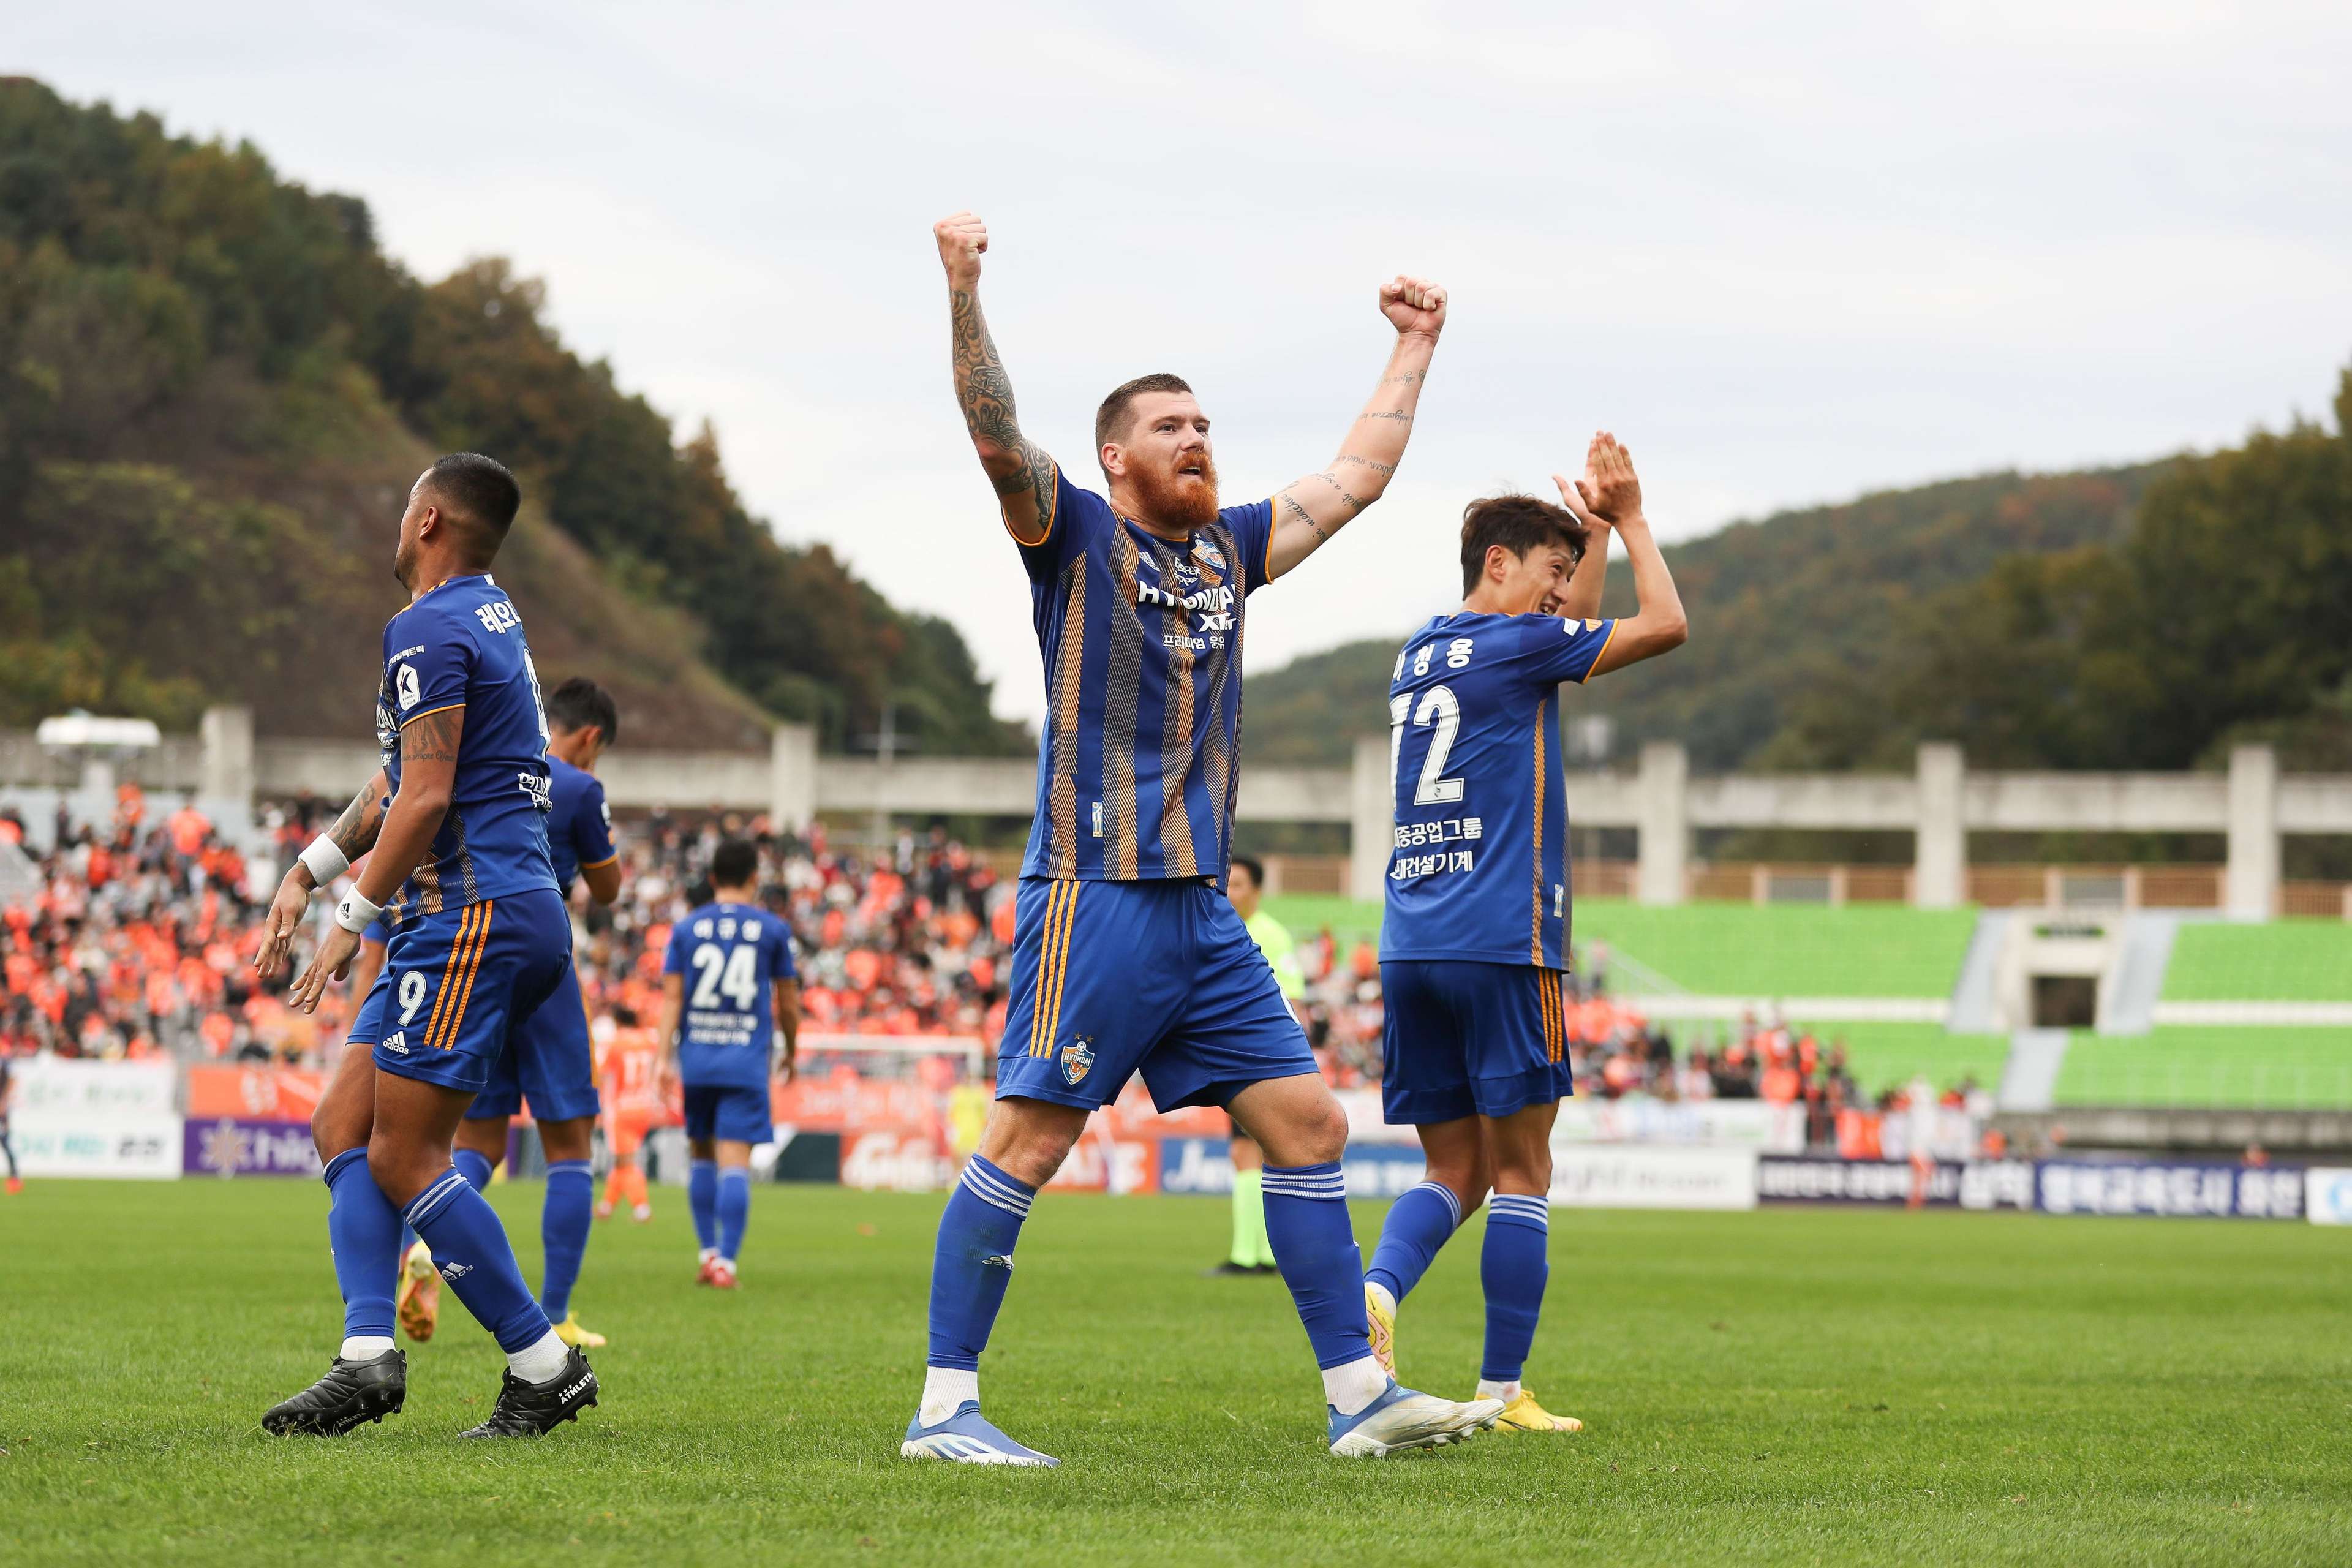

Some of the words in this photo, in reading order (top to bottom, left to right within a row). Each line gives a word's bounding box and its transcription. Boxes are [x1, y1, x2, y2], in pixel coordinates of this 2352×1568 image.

[1163, 635, 1207, 650] 프리미엄
[691, 942, 759, 1011] 24
[398, 970, 427, 1027] 9
[382, 1039, 410, 1055] adidas
[1063, 1052, 1091, 1067] HYUNDAI
[560, 1372, 593, 1405] ATHLETA
